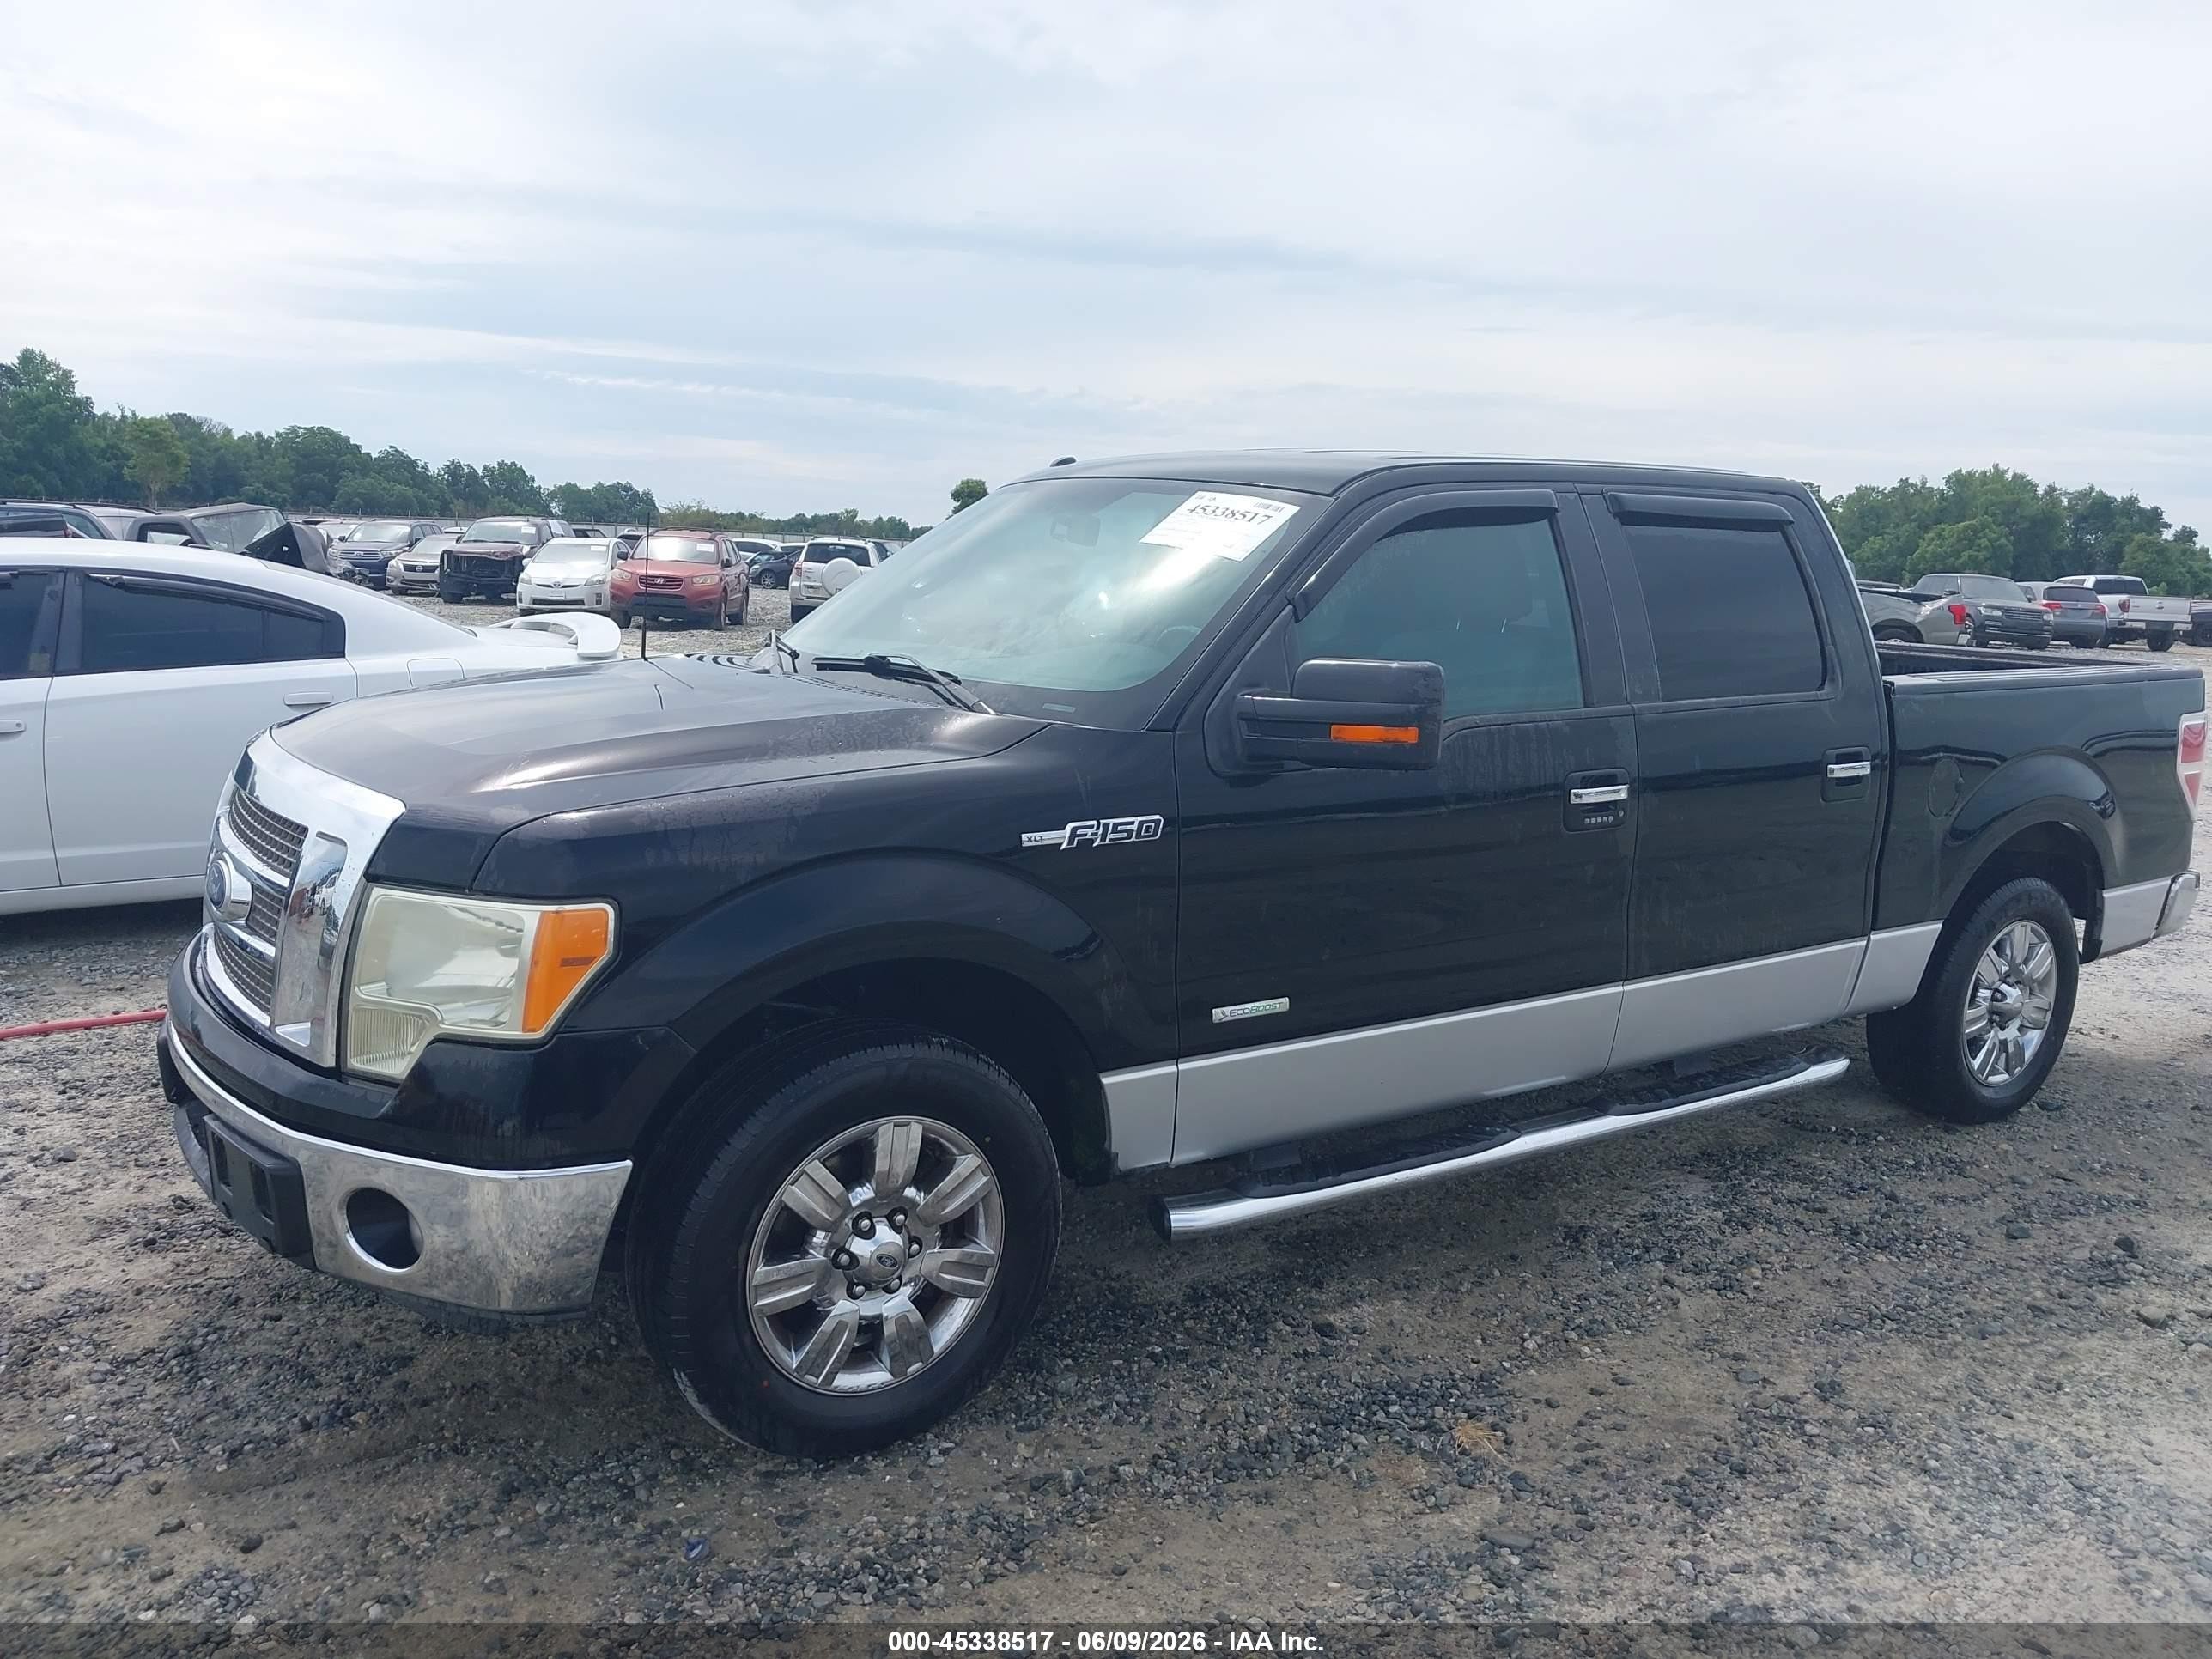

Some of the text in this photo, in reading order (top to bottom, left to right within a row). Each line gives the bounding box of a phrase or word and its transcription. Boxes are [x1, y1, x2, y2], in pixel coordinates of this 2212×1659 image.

[1188, 504, 1273, 525] 45338517
[1060, 815, 1164, 850] F-150
[1229, 1002, 1284, 1017] ECOBOOST
